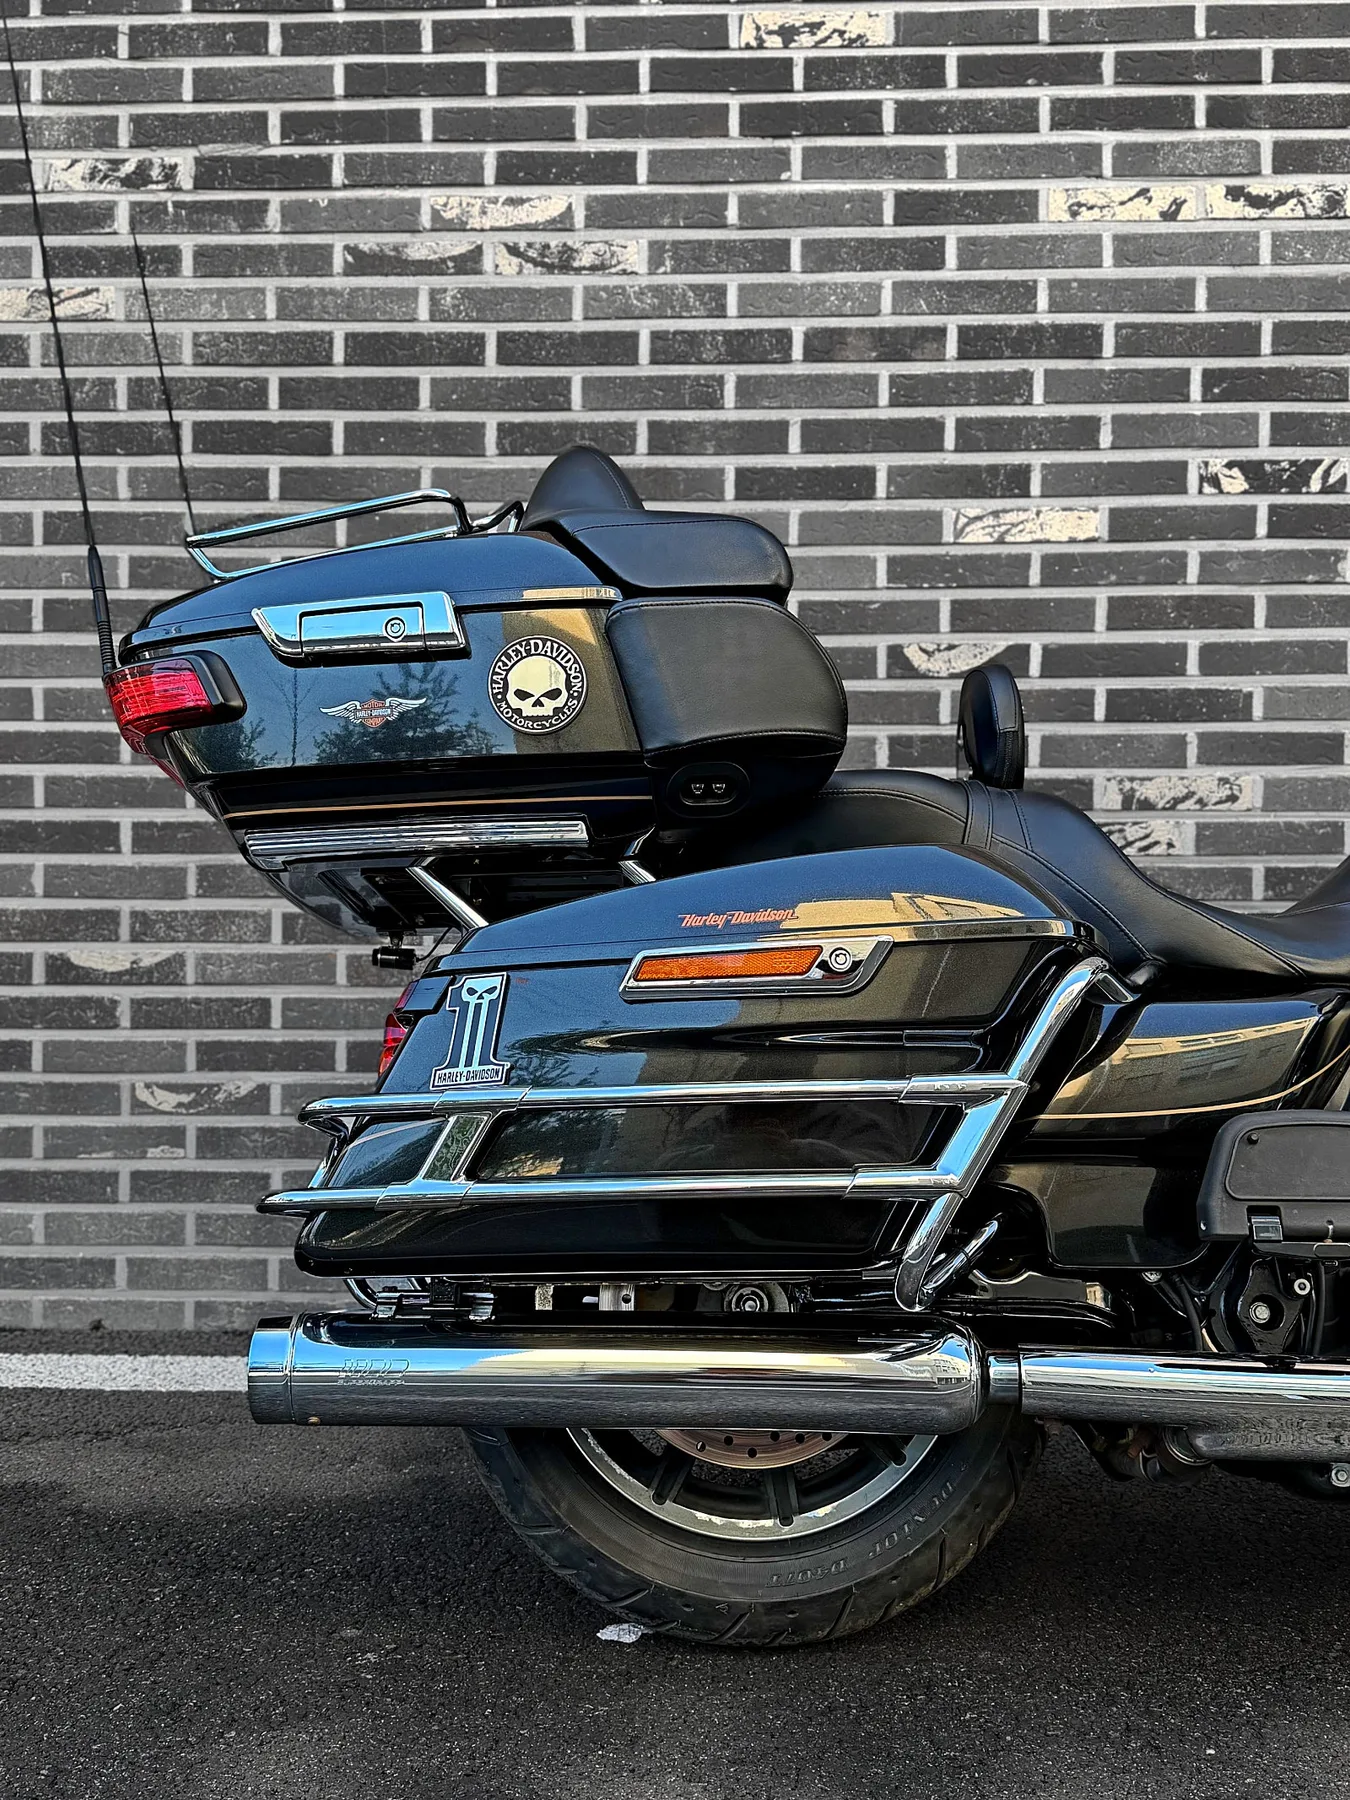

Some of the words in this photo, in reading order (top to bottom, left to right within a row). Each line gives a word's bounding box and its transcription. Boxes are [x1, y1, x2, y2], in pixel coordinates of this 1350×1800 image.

[492, 639, 583, 693] HARLEY-DAVIDSON
[496, 698, 579, 730] MOTORCYCLES
[678, 908, 799, 929] Harley-Davidson
[436, 1067, 501, 1085] HARLEY-DAVIDSON
[765, 1559, 848, 1588] D407T
